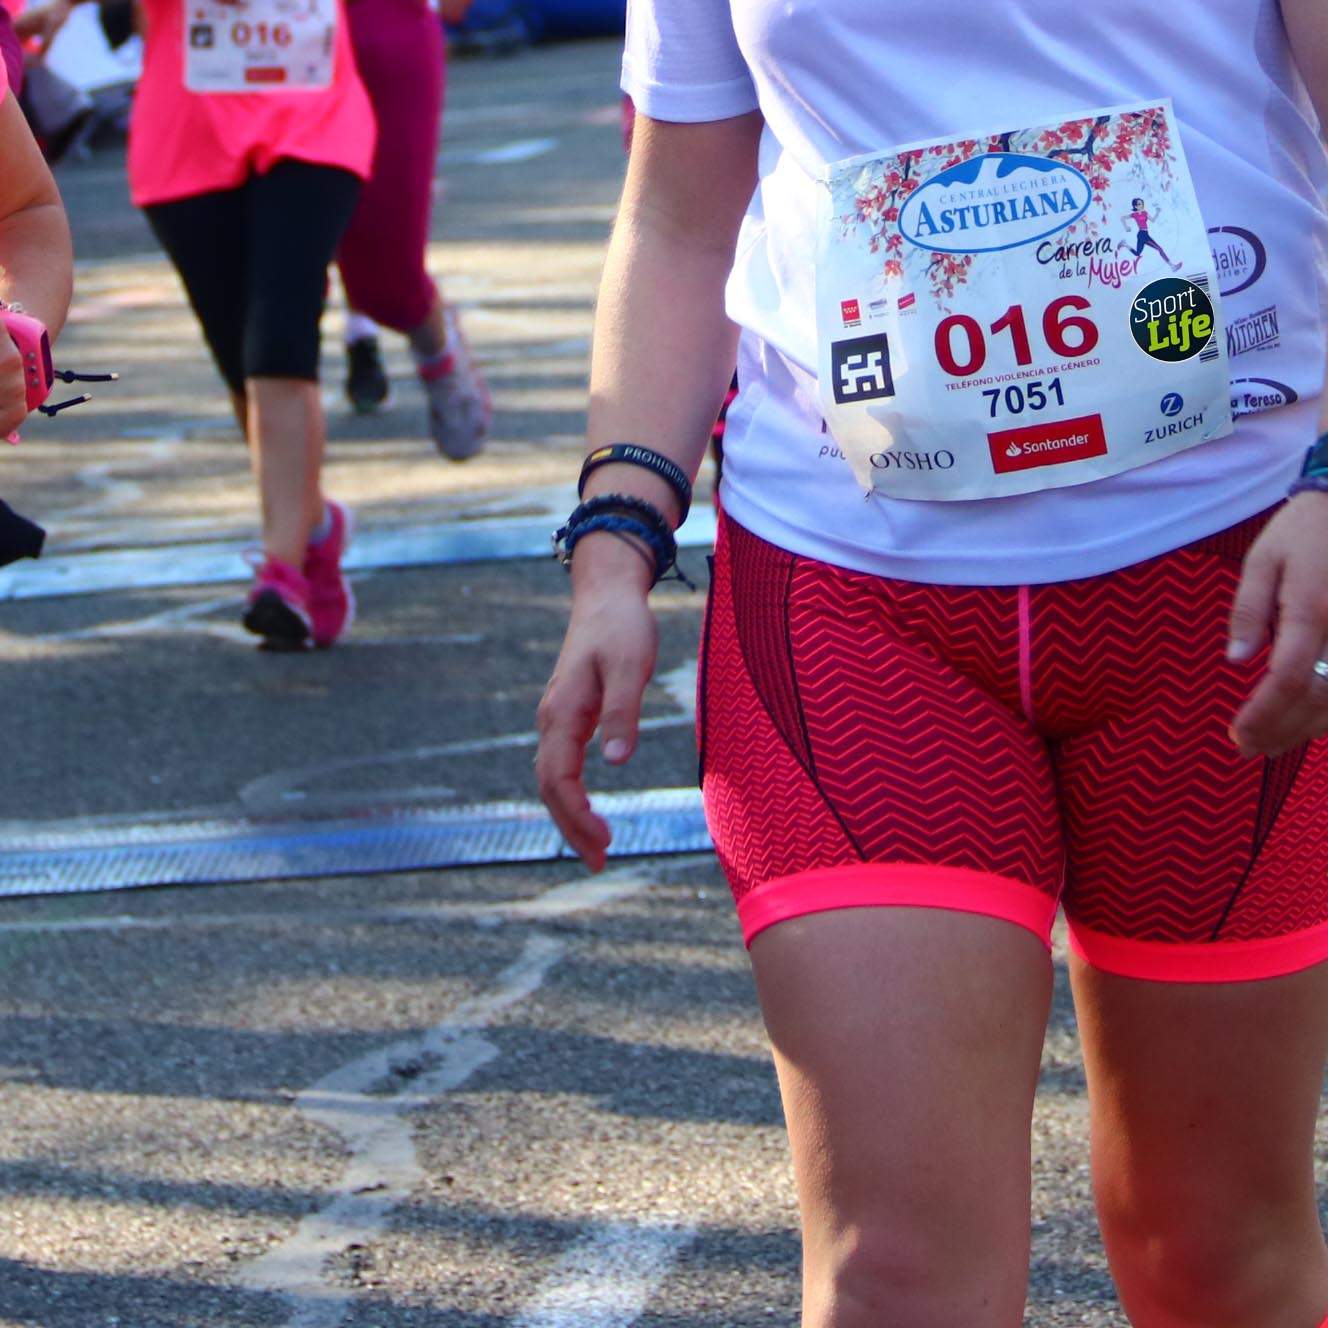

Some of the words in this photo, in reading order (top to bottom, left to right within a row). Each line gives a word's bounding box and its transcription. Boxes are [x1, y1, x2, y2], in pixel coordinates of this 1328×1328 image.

[230, 22, 294, 48] 016
[938, 185, 1002, 205] CENTRAL
[1002, 174, 1068, 195] LECHERA
[913, 187, 1080, 240] ASTURIANA
[1035, 235, 1114, 265] Carrera
[1058, 262, 1073, 281] de
[1076, 262, 1086, 279] la
[1086, 249, 1143, 290] Mujer
[1133, 286, 1197, 324] Sport
[934, 294, 1100, 377] 016
[1147, 309, 1212, 352] Life
[1225, 311, 1280, 359] KITCHEN
[944, 375, 994, 392] TELÉFONO
[994, 367, 1046, 384] VIOLENCIA
[1046, 365, 1060, 375] DE
[981, 376, 1065, 419] 7051
[1022, 431, 1090, 456] Santander
[1144, 412, 1204, 445] ZURICH
[869, 449, 956, 471] OYSHO
